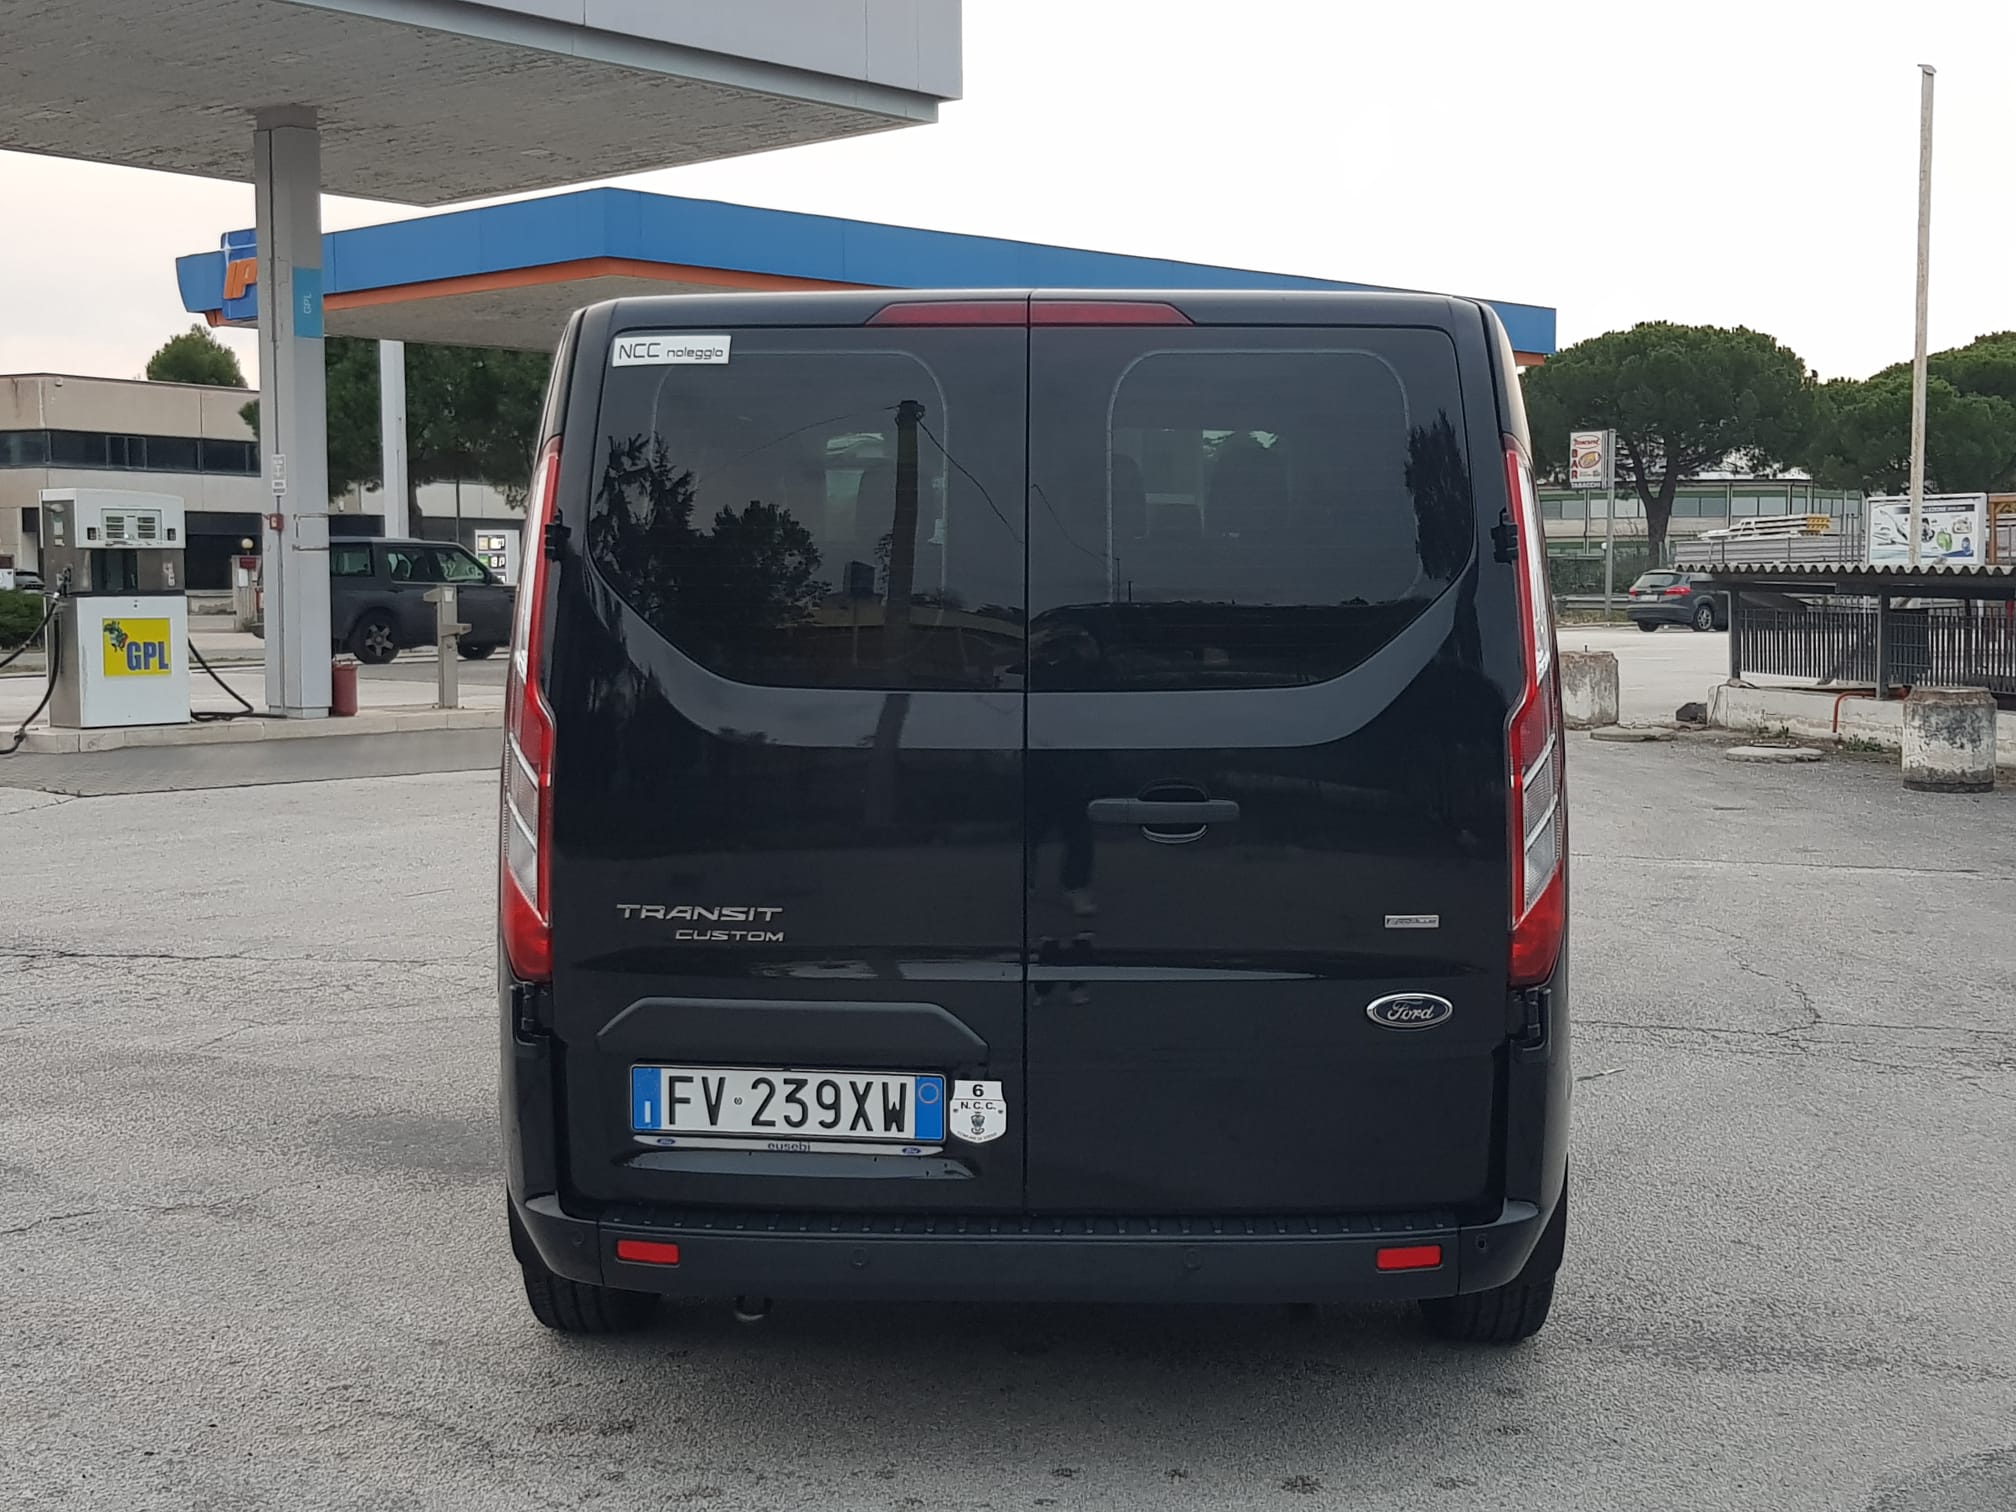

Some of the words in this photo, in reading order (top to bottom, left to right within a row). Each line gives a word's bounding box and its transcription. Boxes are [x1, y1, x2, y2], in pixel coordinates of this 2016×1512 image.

[303, 293, 312, 314] GPL
[619, 343, 661, 360] NCC
[667, 347, 723, 360] noleggio
[127, 641, 169, 671] GPL
[616, 904, 783, 921] TRANSIT
[675, 930, 784, 942] CUSTOM
[1387, 1000, 1435, 1020] Ford
[972, 1084, 984, 1097] 6
[767, 1141, 811, 1153] eusebi
